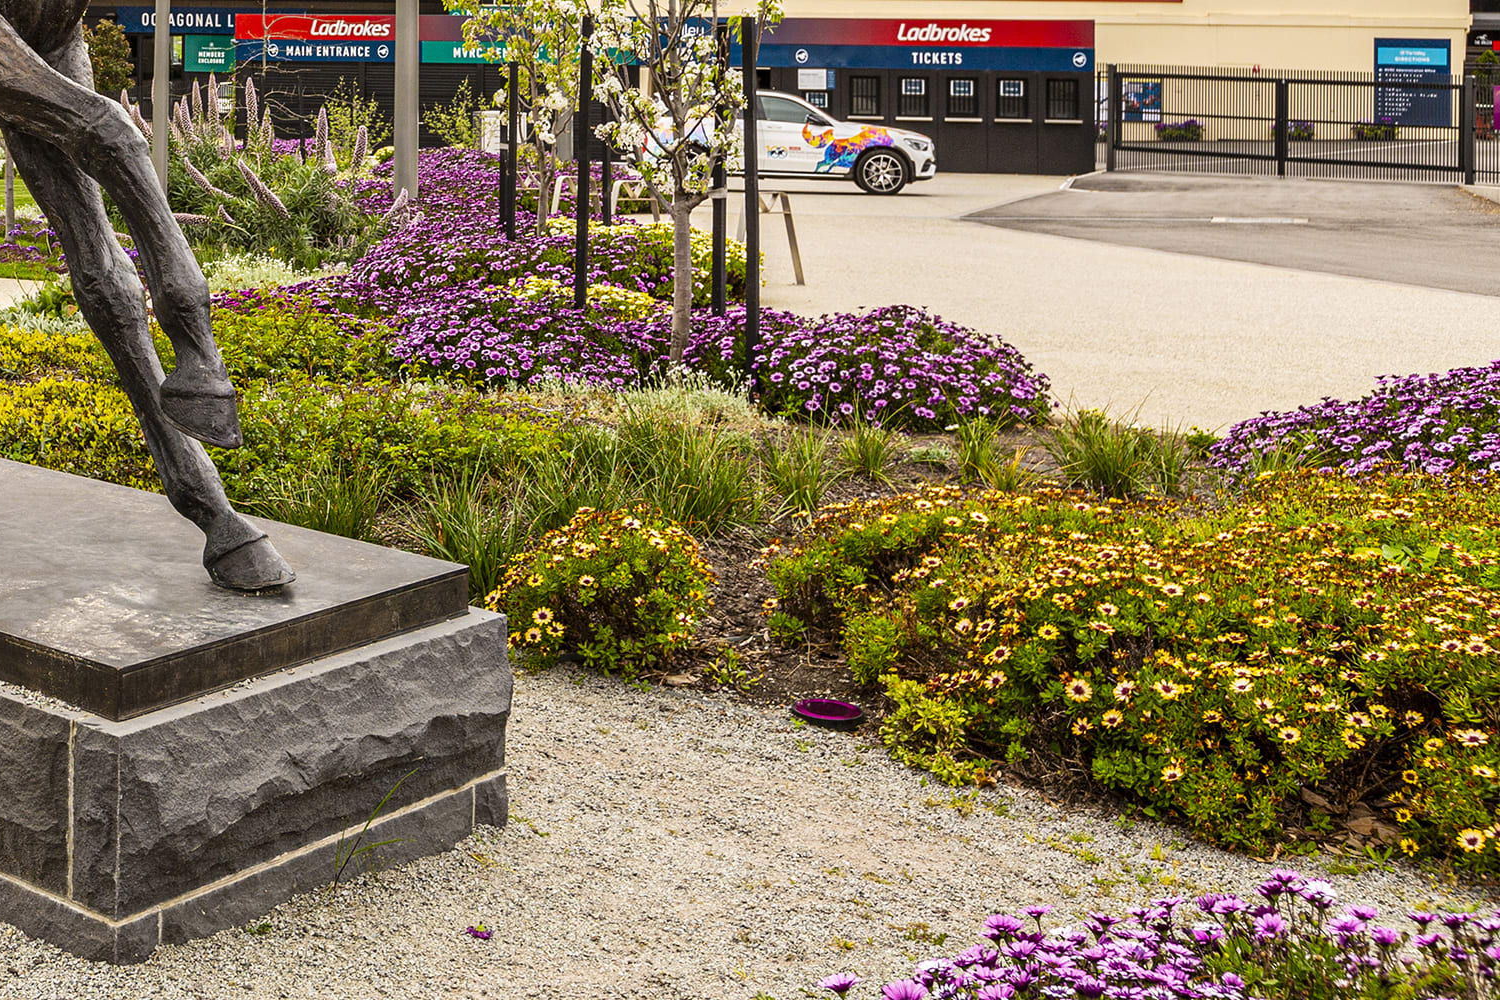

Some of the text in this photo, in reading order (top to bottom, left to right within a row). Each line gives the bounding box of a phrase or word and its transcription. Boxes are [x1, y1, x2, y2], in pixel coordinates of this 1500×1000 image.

[141, 12, 222, 27] OCAGONAL
[310, 20, 391, 36] Ladbrokes
[897, 23, 992, 42] Ladbrokes
[285, 45, 371, 57] MAIN ENTRANCE
[453, 47, 483, 58] MVRC
[911, 52, 963, 65] TICKETS
